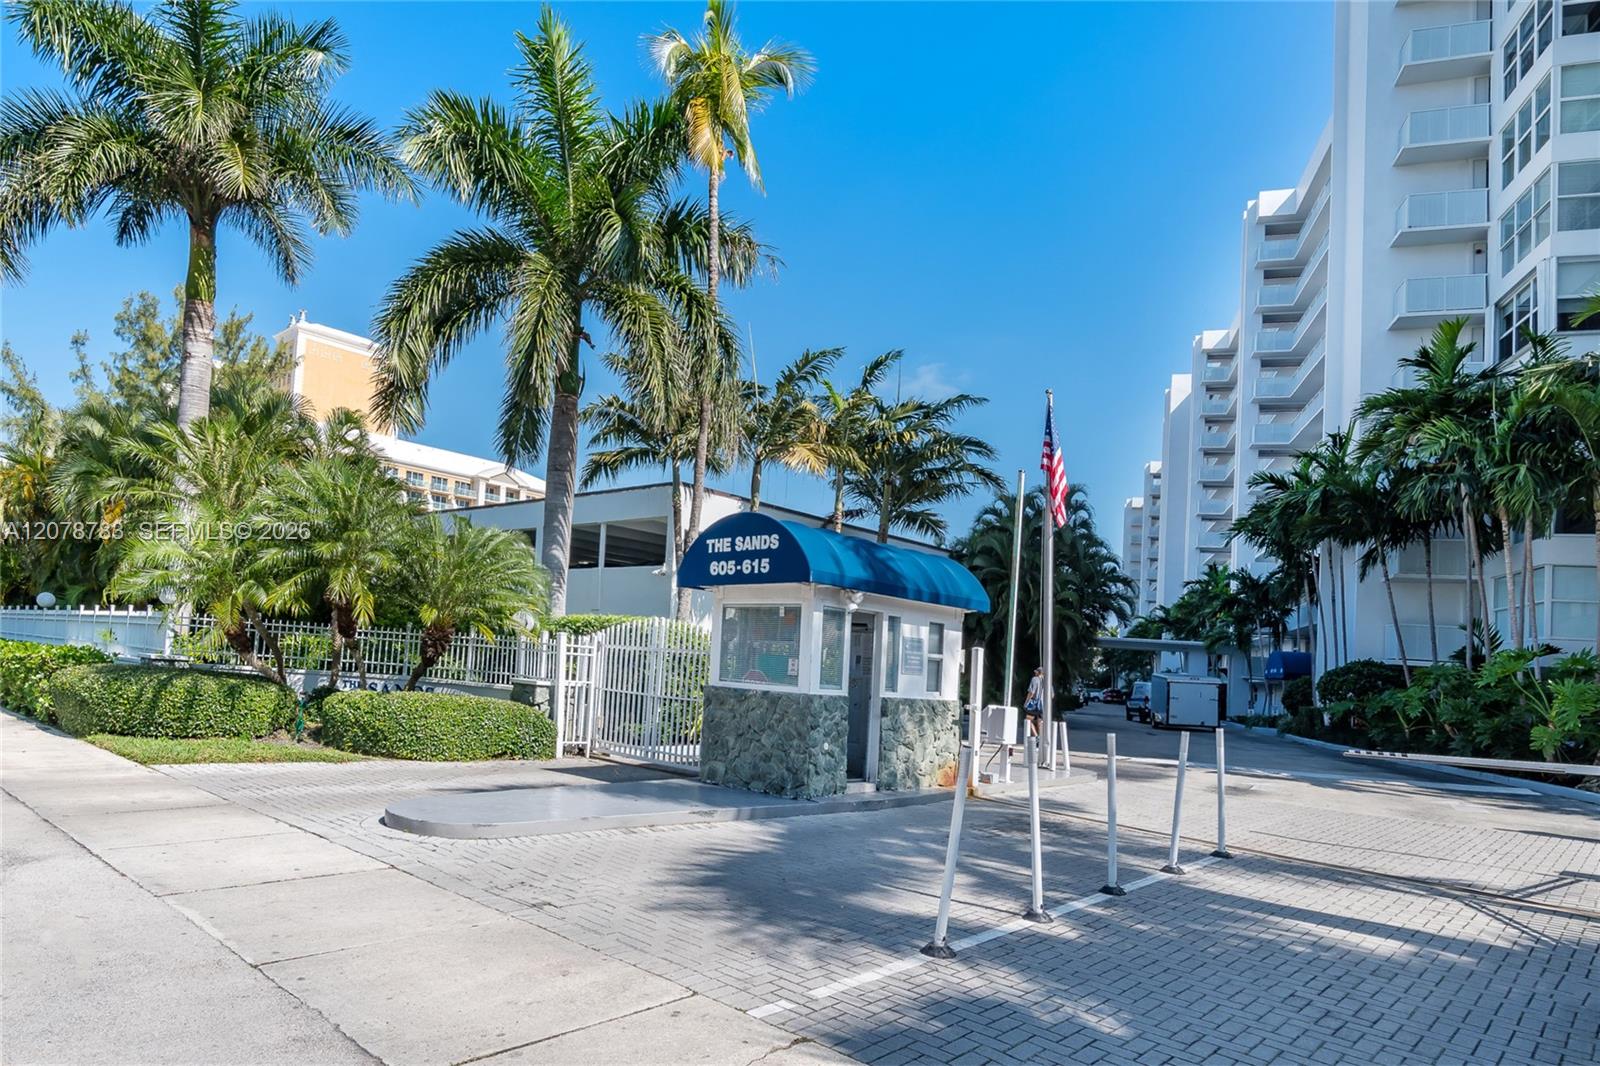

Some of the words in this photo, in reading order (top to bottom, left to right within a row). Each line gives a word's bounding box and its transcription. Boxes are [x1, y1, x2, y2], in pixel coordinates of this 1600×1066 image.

[706, 537, 732, 553] THE
[735, 534, 780, 551] SANDS
[710, 558, 770, 575] 605-615
